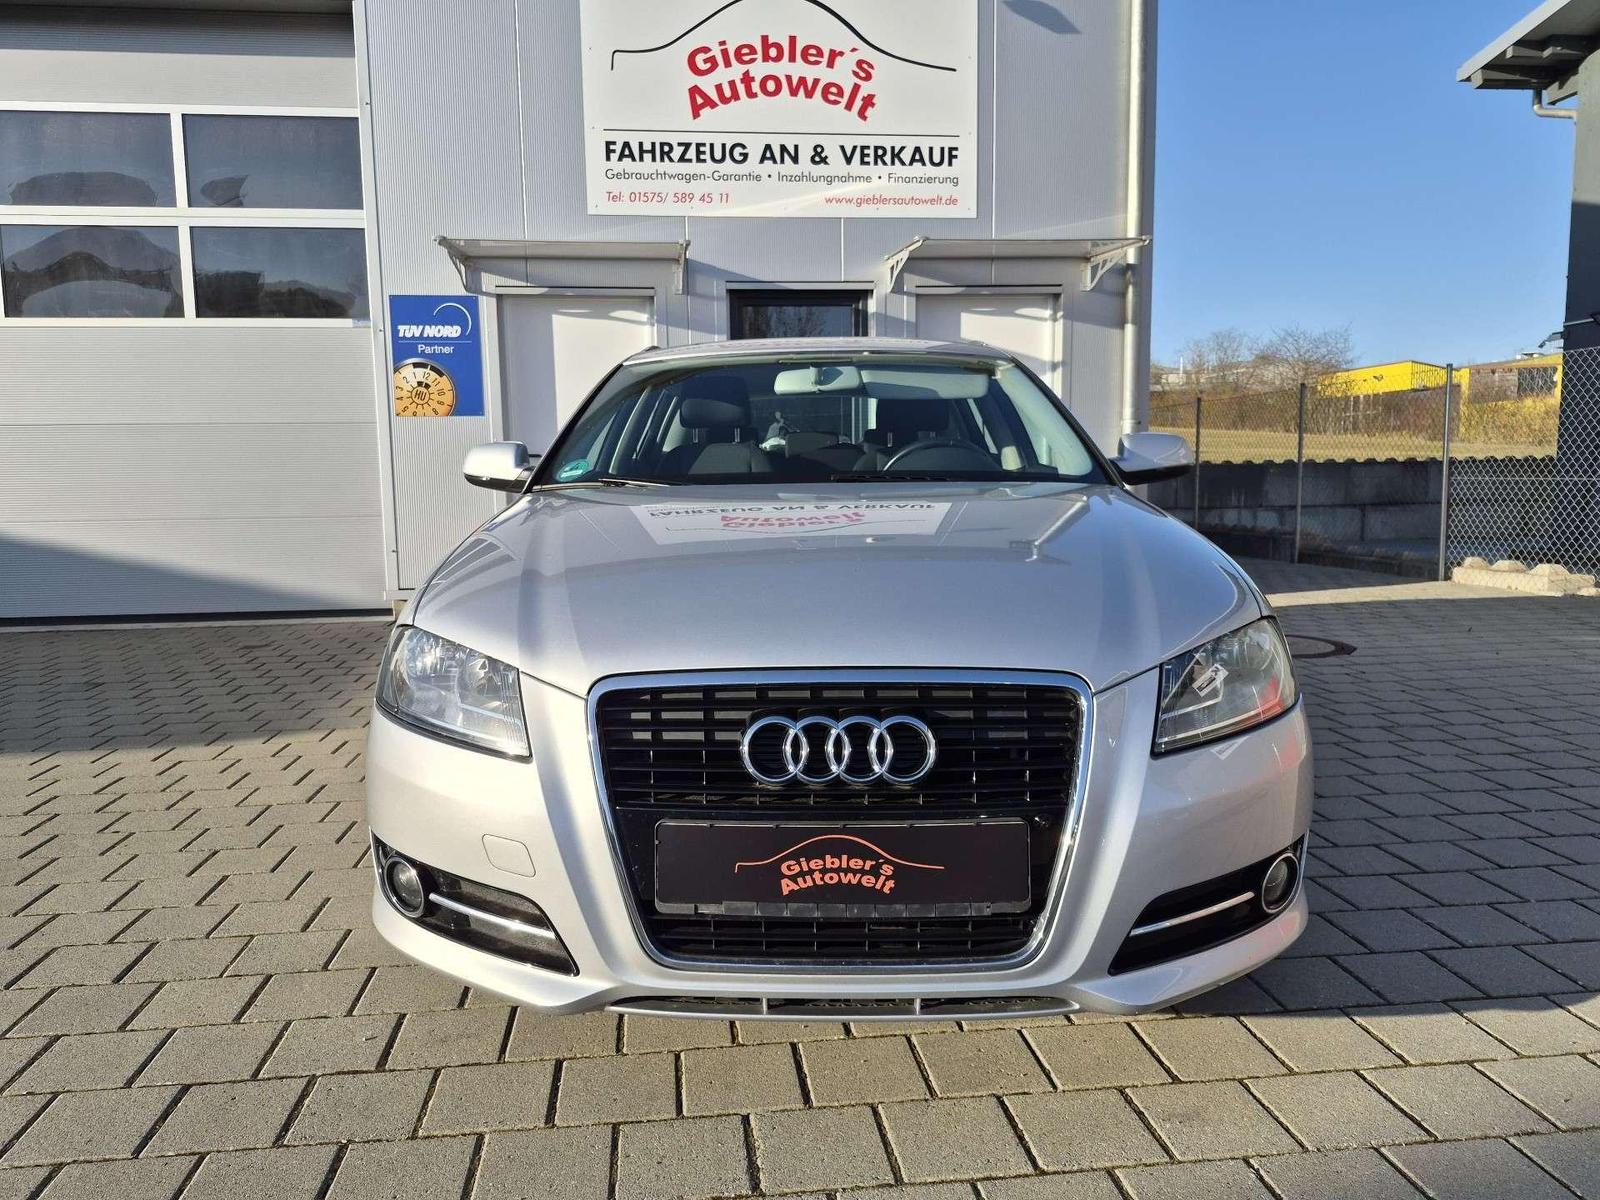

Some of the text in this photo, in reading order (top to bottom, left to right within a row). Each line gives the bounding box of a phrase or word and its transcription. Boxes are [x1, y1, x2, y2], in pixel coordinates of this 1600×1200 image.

[687, 69, 877, 121] Autowelt
[605, 140, 959, 168] FAHRZEUG AN & VERKAUF
[604, 168, 959, 187] Gebrauchtwagen-Garantie Inzahlungnahme Finanzierung
[606, 191, 730, 204] Tel: 01575/ 589 45 11
[824, 194, 959, 208] www.gieblersautowelt.de
[423, 325, 462, 338] NORD
[417, 344, 455, 354] Partner
[422, 371, 431, 381] 12
[414, 389, 427, 401] HU
[436, 388, 446, 396] 10
[780, 869, 895, 896] Autowelt
